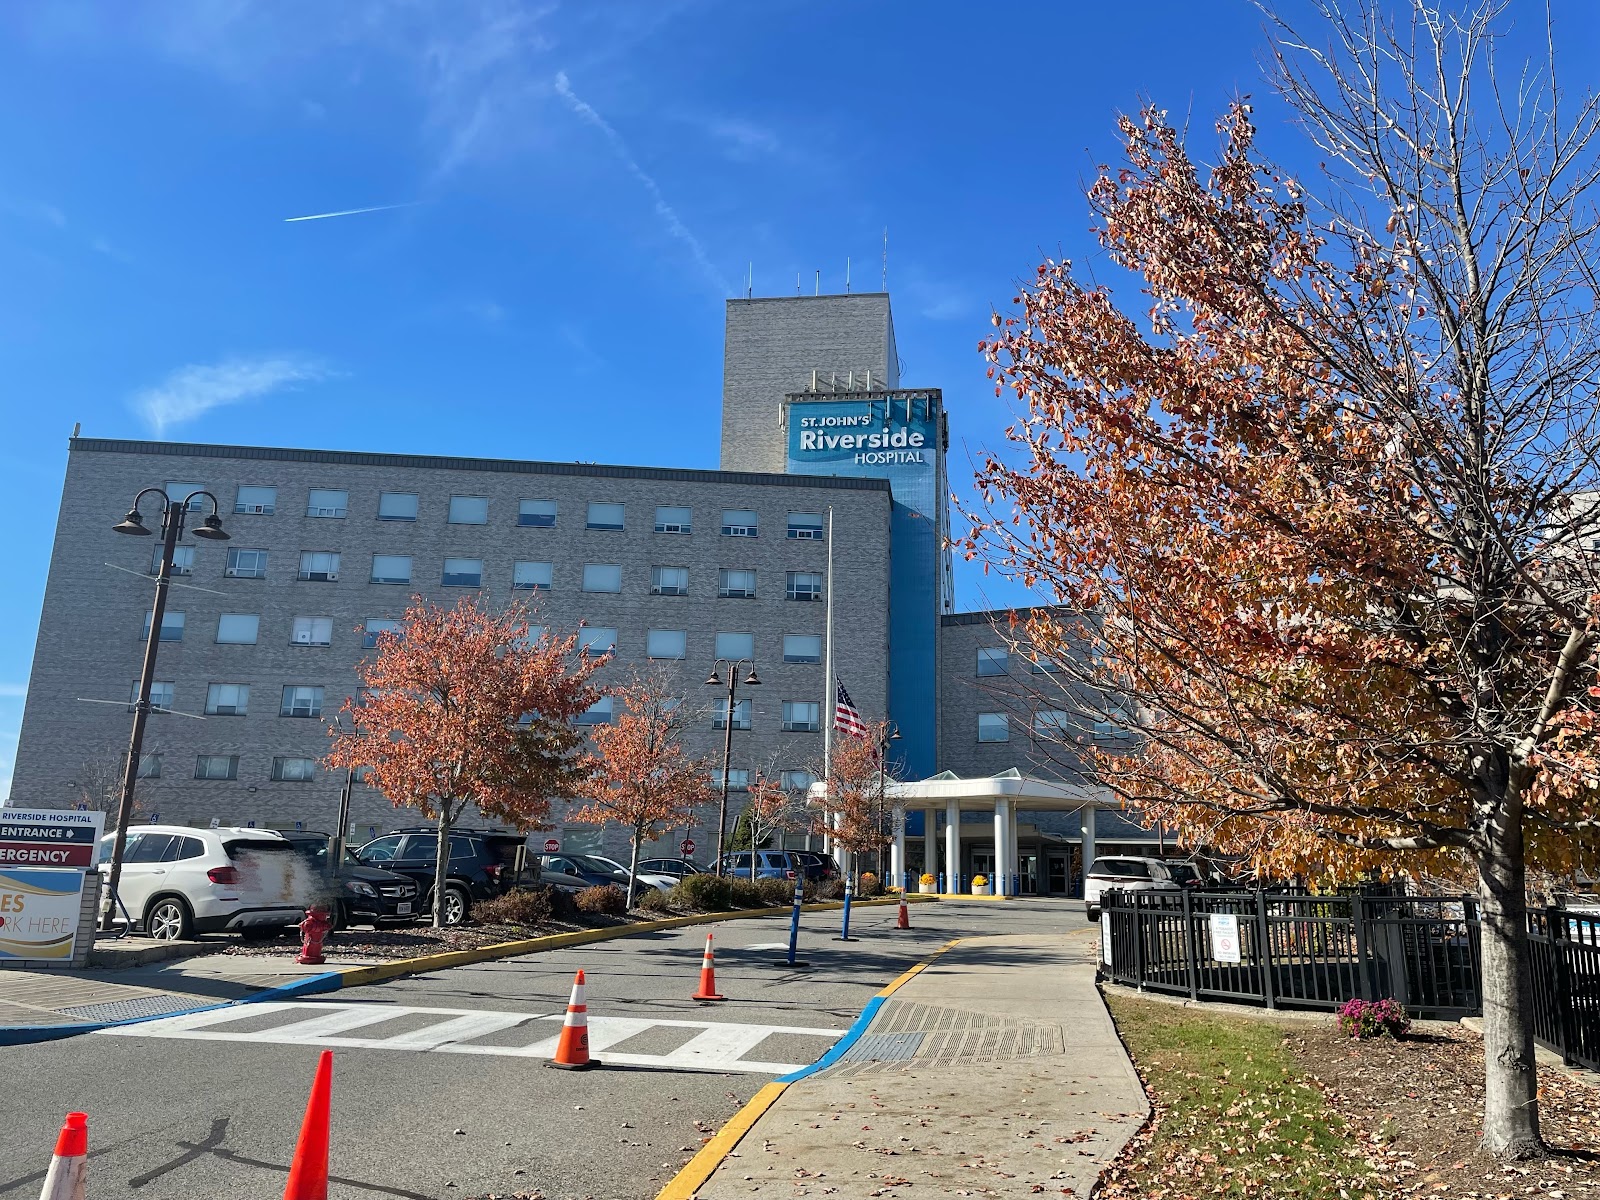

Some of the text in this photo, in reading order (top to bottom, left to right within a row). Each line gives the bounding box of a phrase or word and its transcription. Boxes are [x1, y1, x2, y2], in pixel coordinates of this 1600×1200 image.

[800, 426, 925, 450] Riverside
[854, 451, 924, 465] HOSPITAL
[2, 812, 92, 823] RIVERSIDE HOSPITAL
[1, 827, 63, 838] ENTRANCE
[544, 843, 559, 851] STOP
[1, 894, 25, 913] ES
[28, 916, 70, 934] HERE
